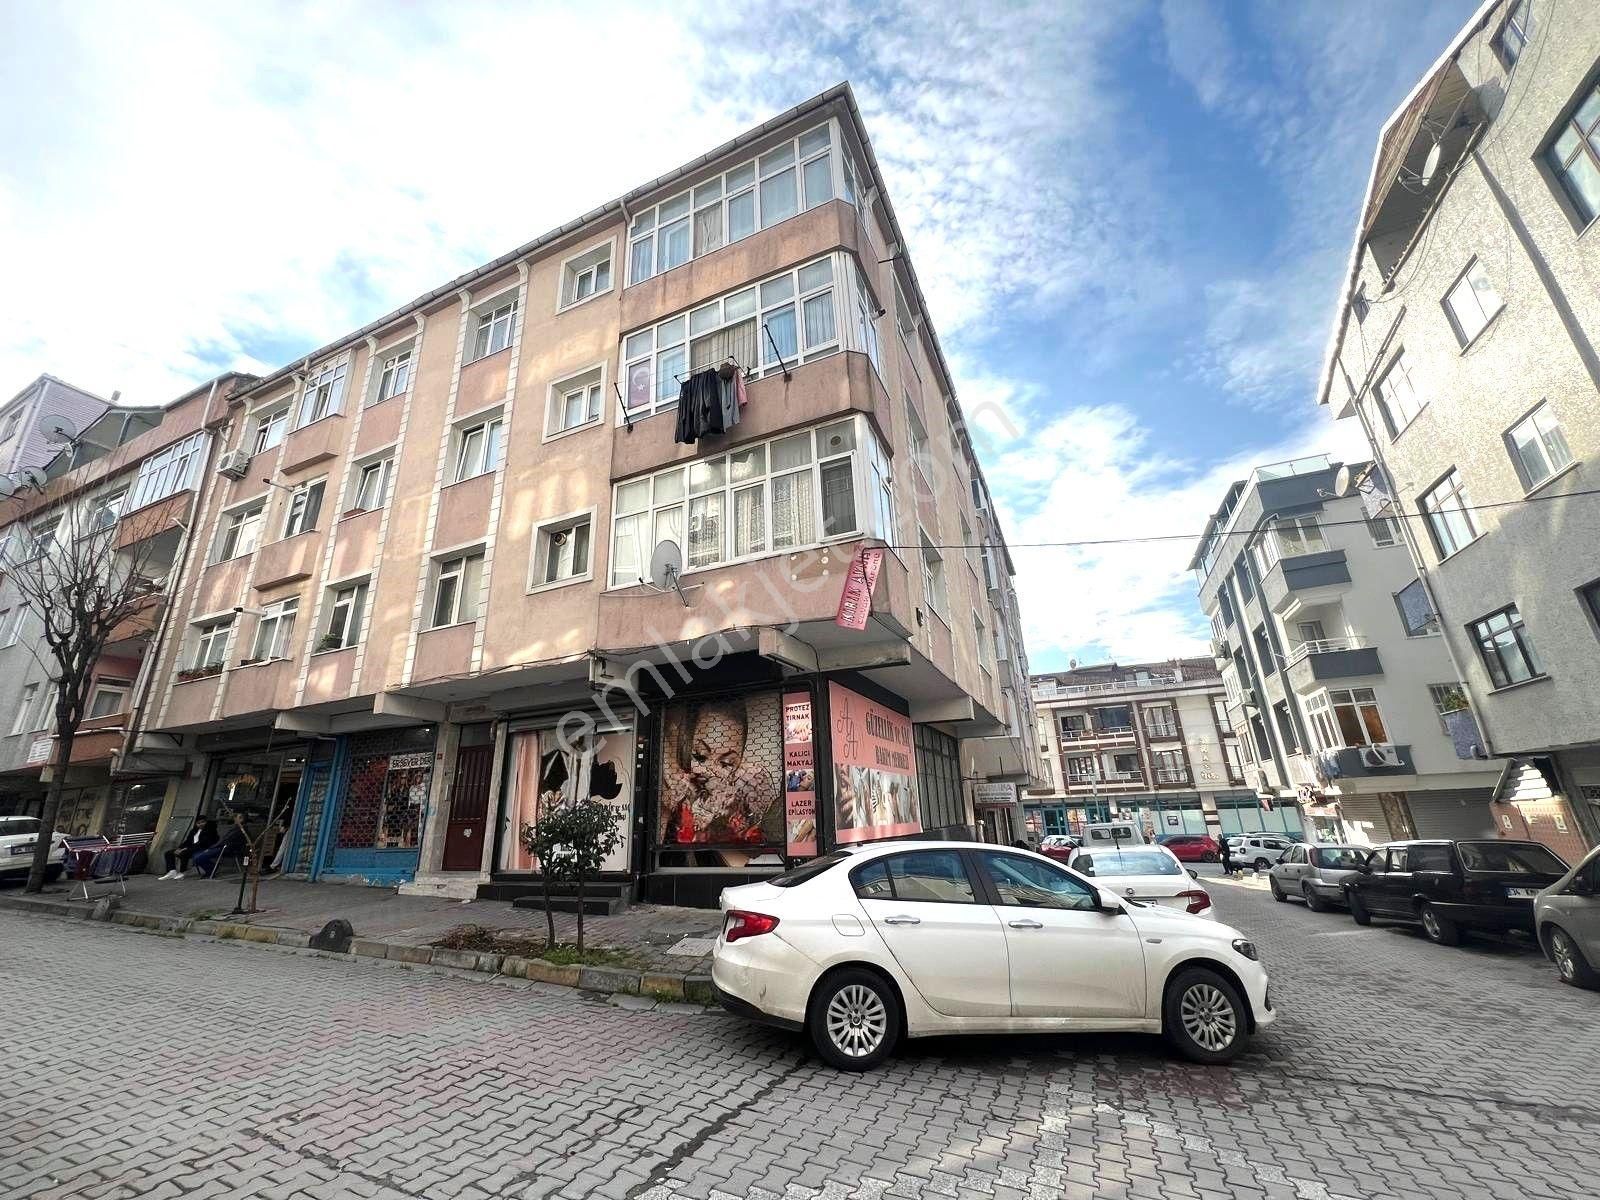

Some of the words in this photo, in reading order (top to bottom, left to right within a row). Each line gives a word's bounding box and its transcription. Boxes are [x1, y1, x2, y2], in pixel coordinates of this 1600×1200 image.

[785, 704, 810, 712] PROTEZ
[785, 713, 810, 721] TIRNAK
[789, 750, 811, 758] KALICI
